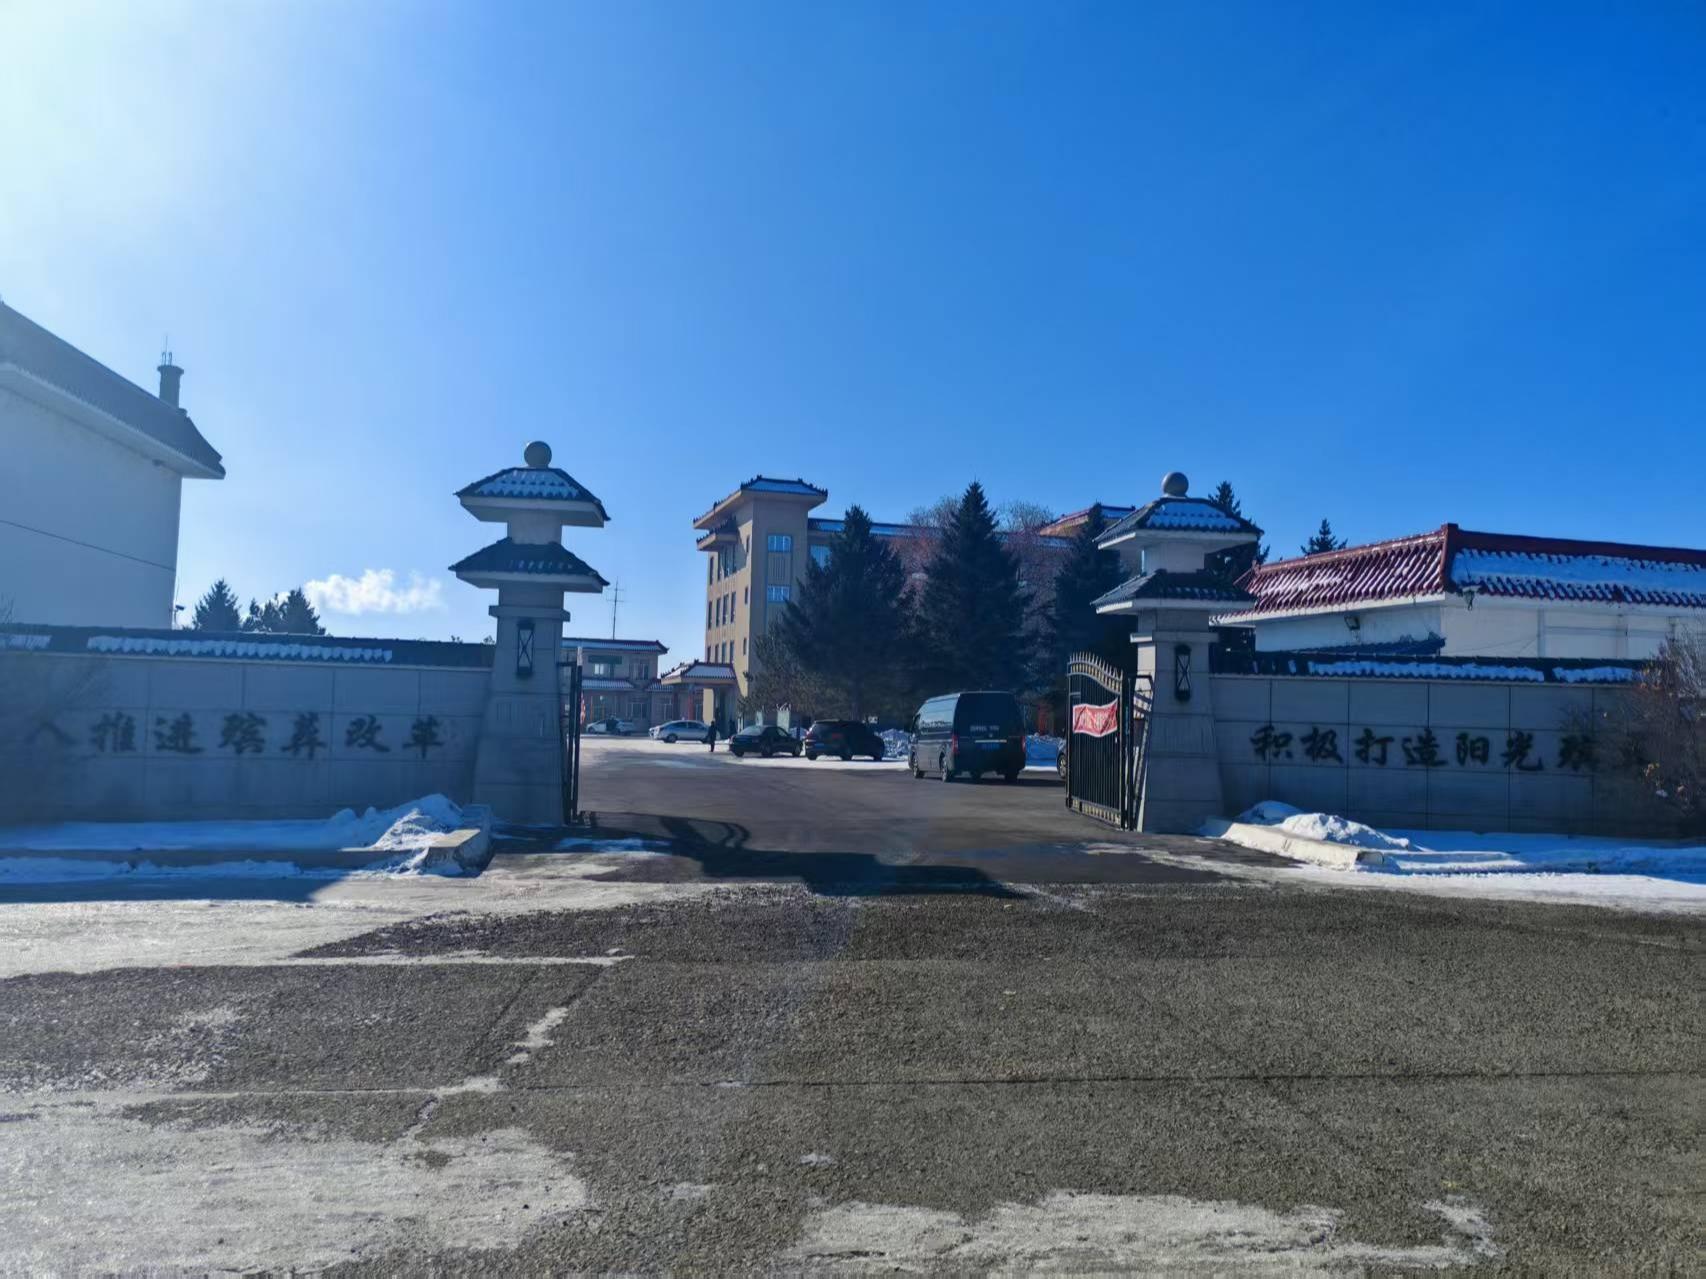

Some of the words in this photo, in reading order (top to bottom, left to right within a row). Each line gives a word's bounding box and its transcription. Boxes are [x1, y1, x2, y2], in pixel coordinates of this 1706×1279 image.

[1249, 723, 1648, 773] 积极打造阳光殡
